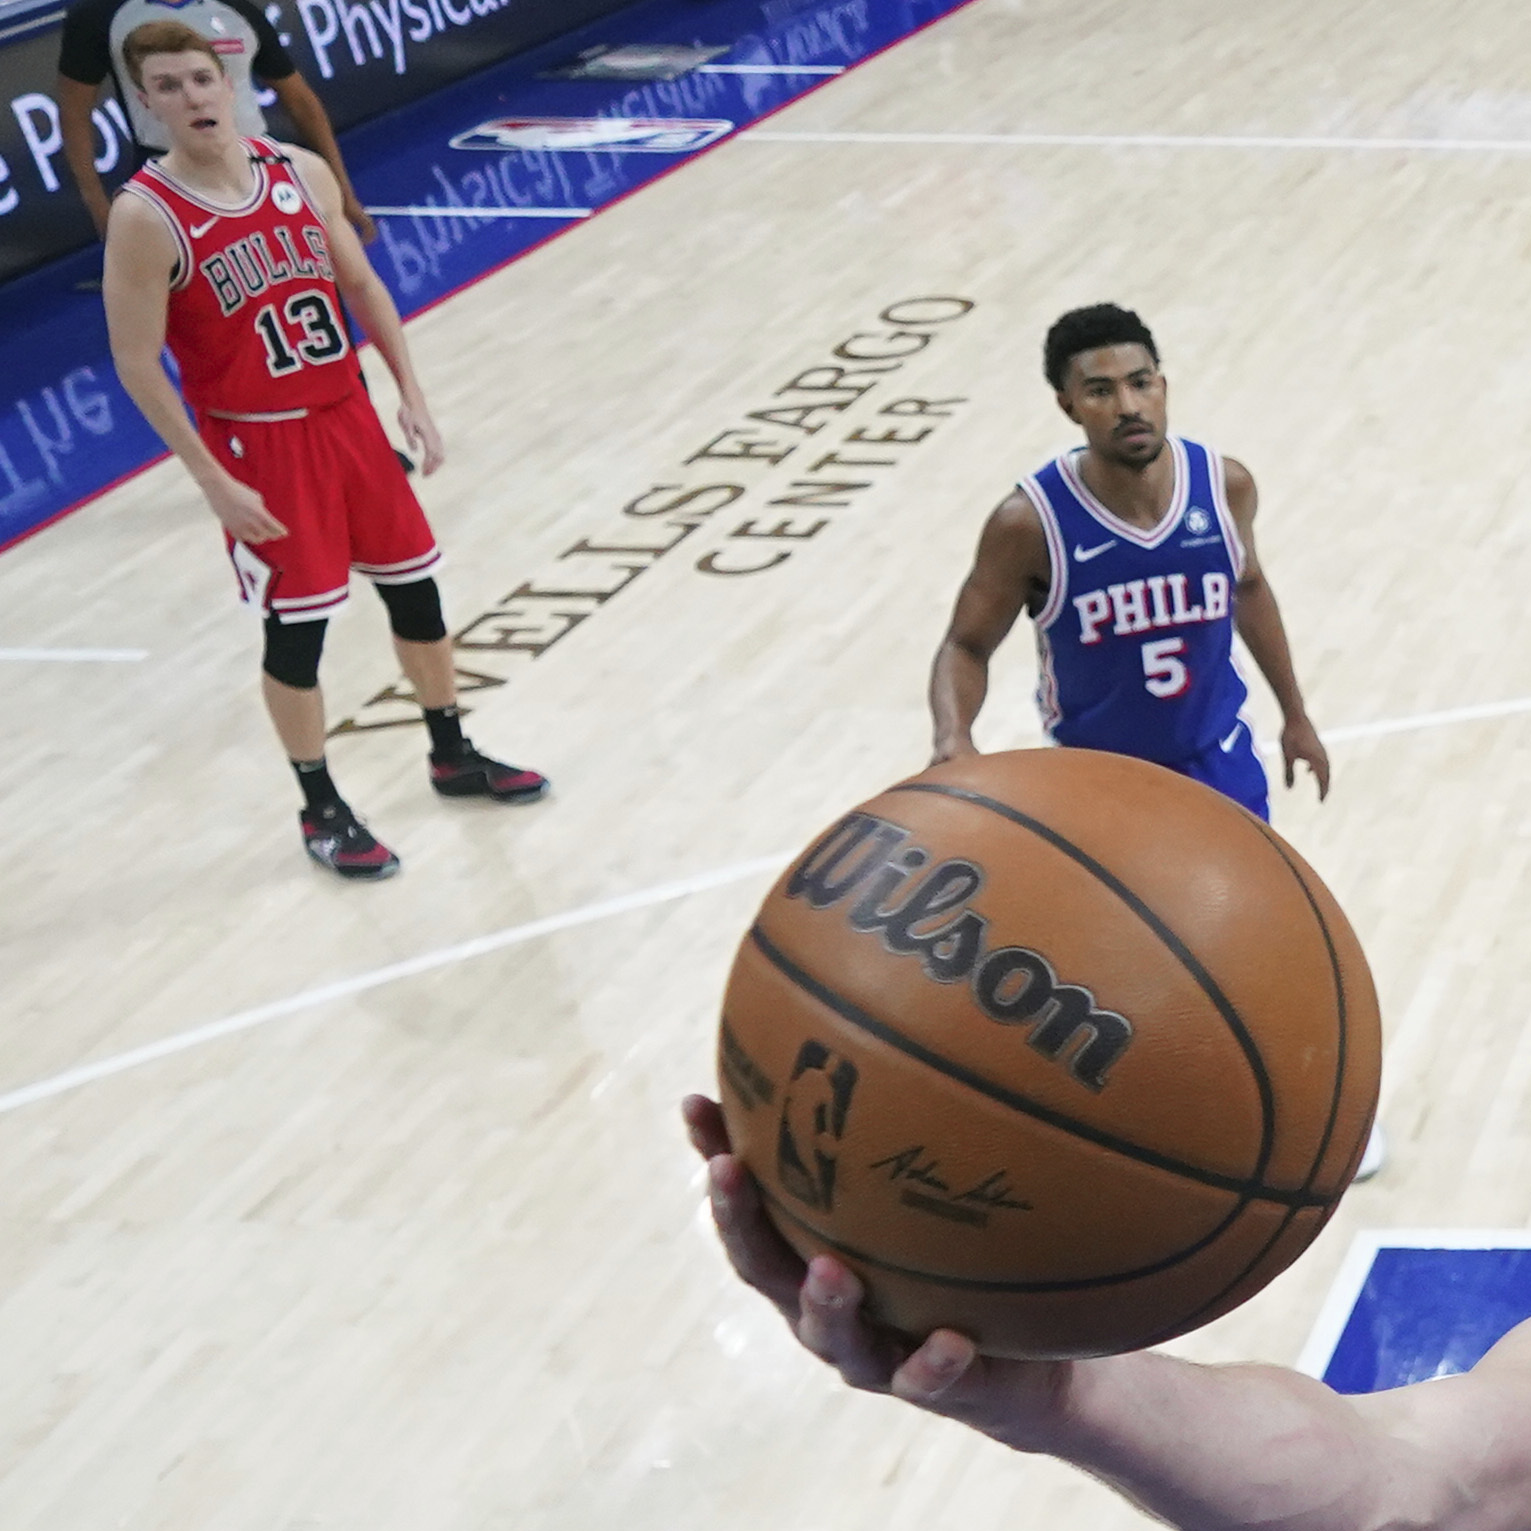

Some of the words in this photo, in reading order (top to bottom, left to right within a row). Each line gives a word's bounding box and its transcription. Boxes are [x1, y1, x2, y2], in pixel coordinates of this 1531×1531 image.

[200, 225, 336, 318] BULLS
[254, 288, 350, 379] 13
[326, 481, 746, 740] WELLS
[683, 295, 976, 468] FARGO
[694, 394, 969, 577] CENTER
[1072, 572, 1230, 645] PHILA
[1141, 636, 1191, 700] 5
[785, 811, 1134, 1094] Wilson
